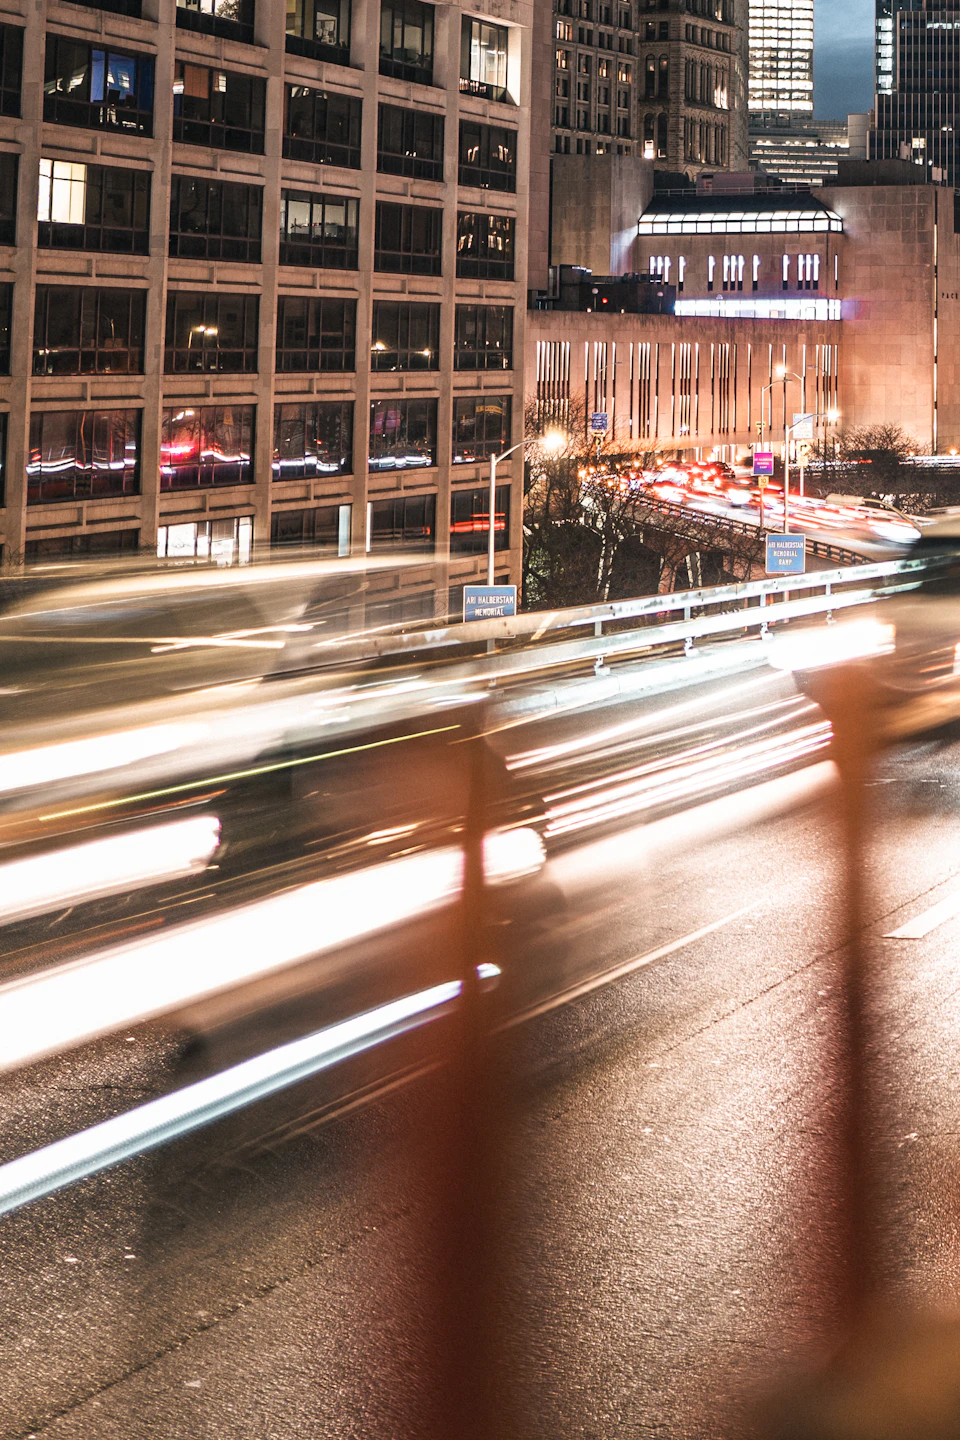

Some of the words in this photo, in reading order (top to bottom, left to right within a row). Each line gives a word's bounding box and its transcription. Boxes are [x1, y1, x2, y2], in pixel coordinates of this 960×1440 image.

[466, 596, 476, 605] ARI
[477, 595, 514, 604] HALBERSTAM
[474, 608, 504, 617] MEMORIAL
